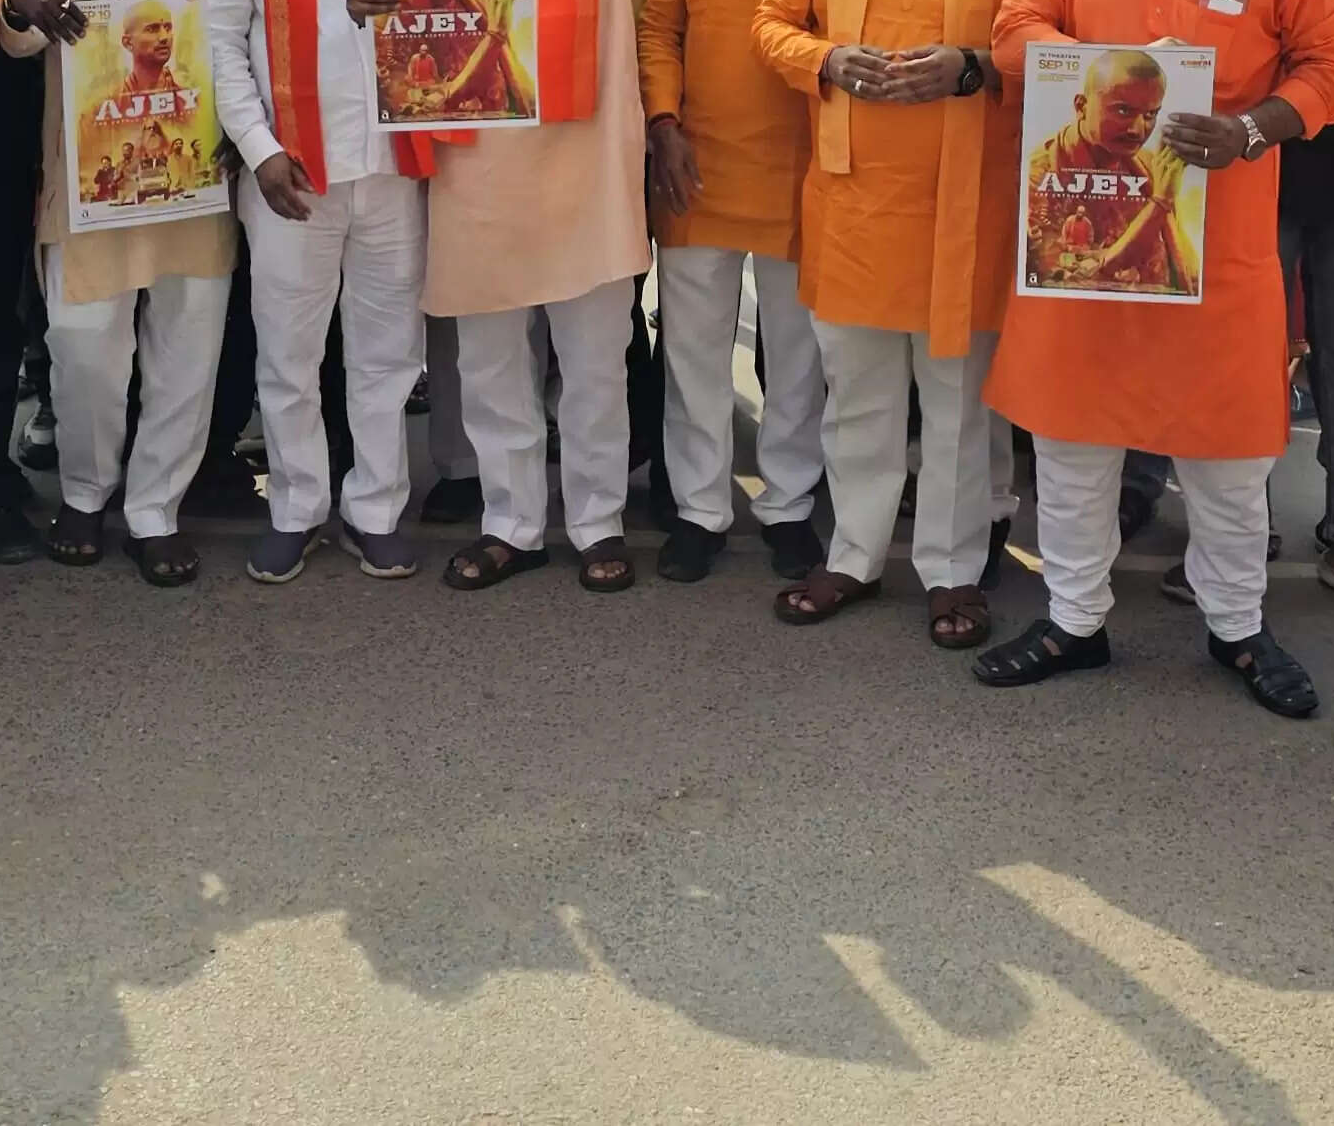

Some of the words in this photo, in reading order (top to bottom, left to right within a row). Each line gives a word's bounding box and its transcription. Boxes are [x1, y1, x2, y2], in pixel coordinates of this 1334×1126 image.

[381, 12, 484, 35] AJEY
[1038, 59, 1064, 70] SEP
[1065, 60, 1080, 71] 19
[95, 88, 201, 122] AJEY
[1037, 171, 1150, 196] AJEY
